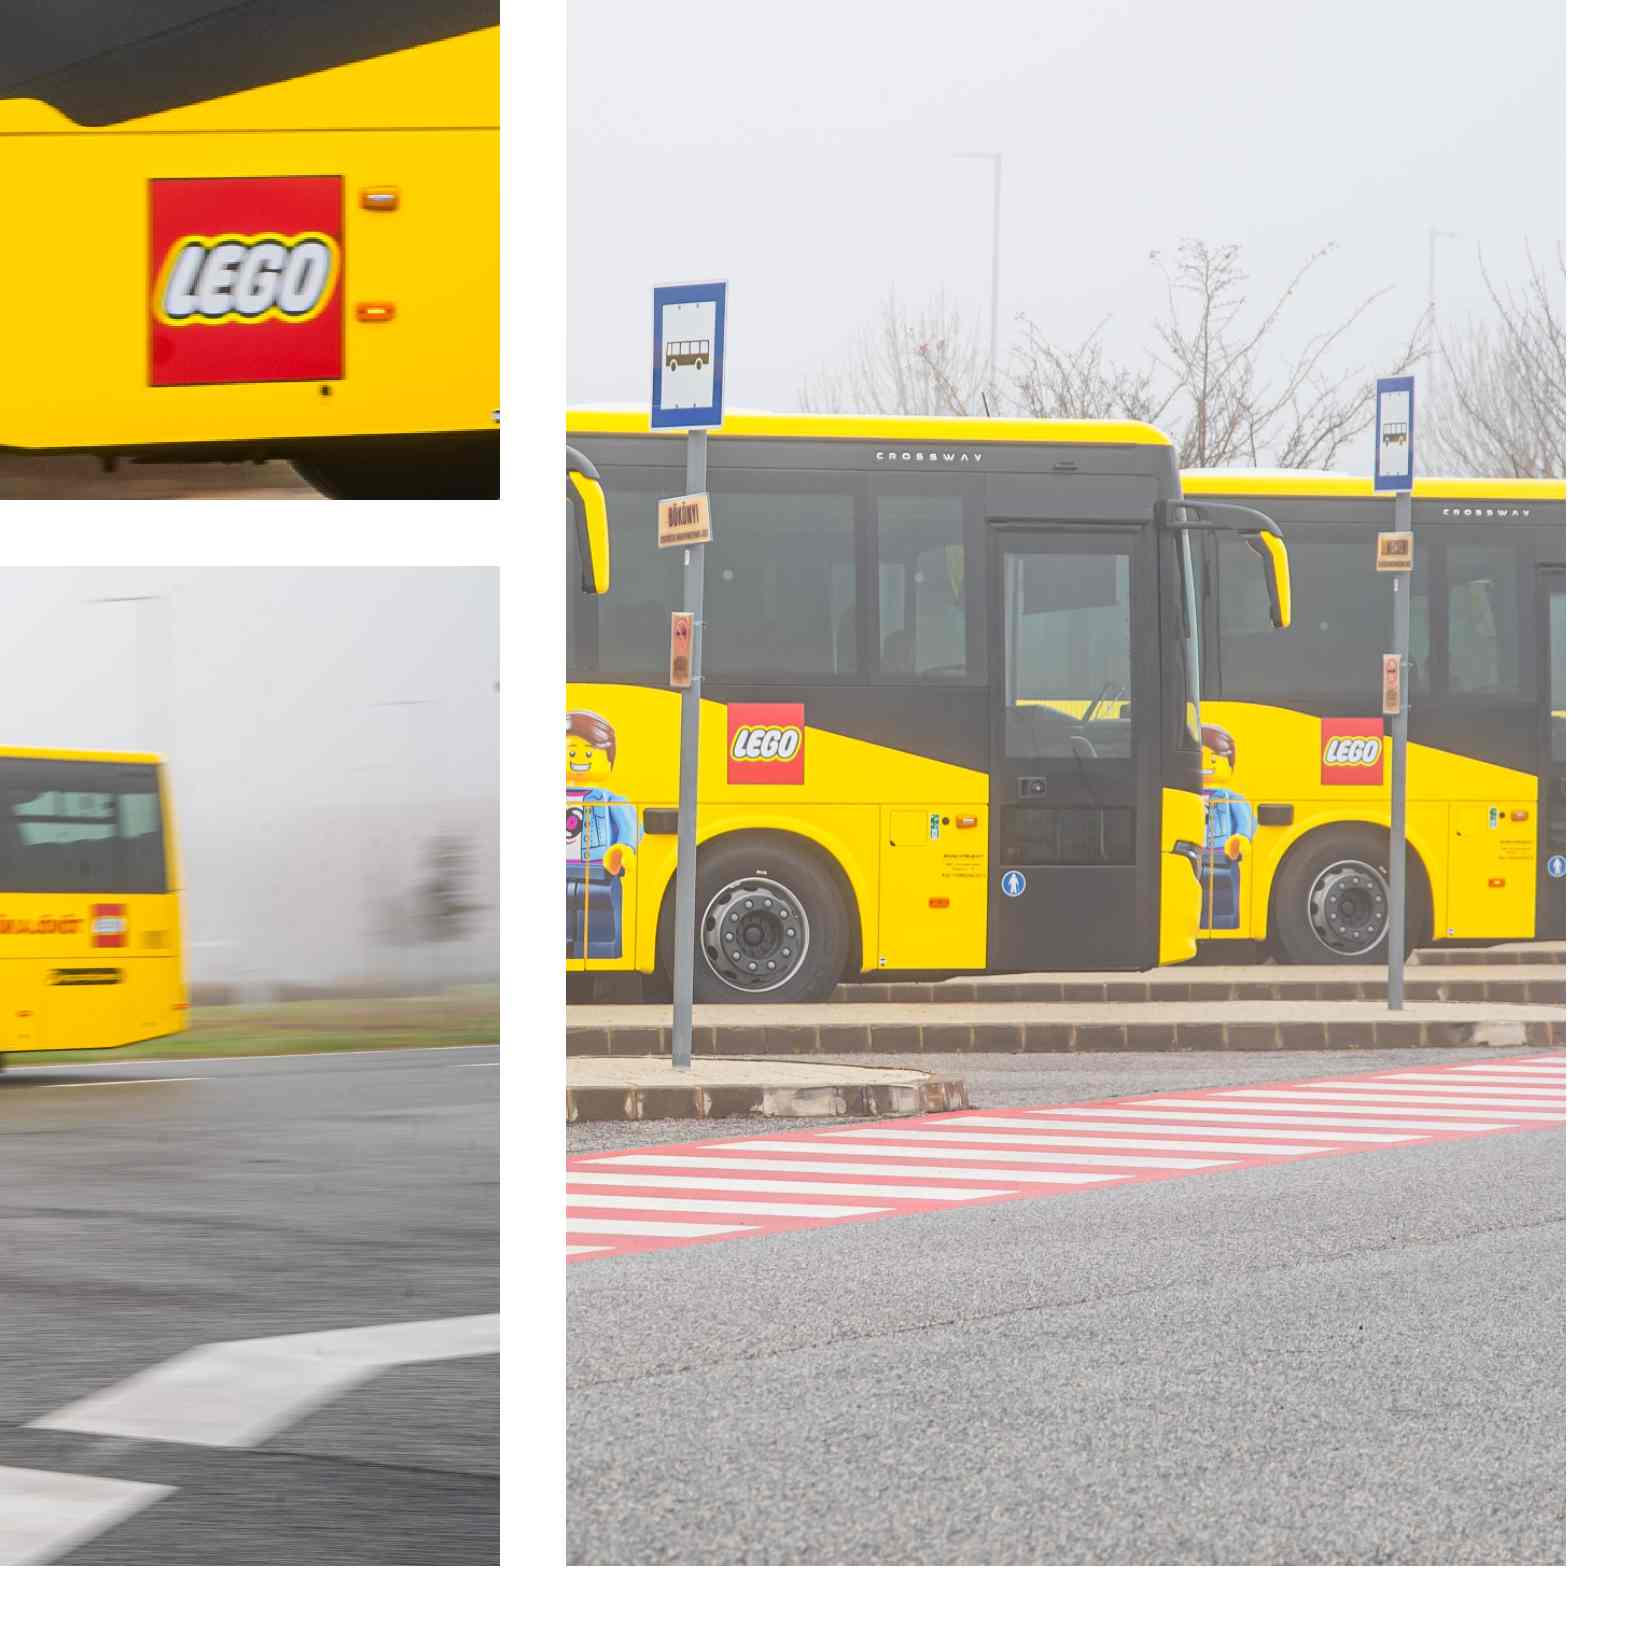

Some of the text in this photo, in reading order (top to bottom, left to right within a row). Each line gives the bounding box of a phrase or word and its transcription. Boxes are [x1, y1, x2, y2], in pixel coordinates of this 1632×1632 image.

[161, 237, 333, 319] LEGO
[875, 451, 983, 462] CROSSWAY
[732, 727, 800, 759] LEGO
[1325, 738, 1380, 764] LEGO
